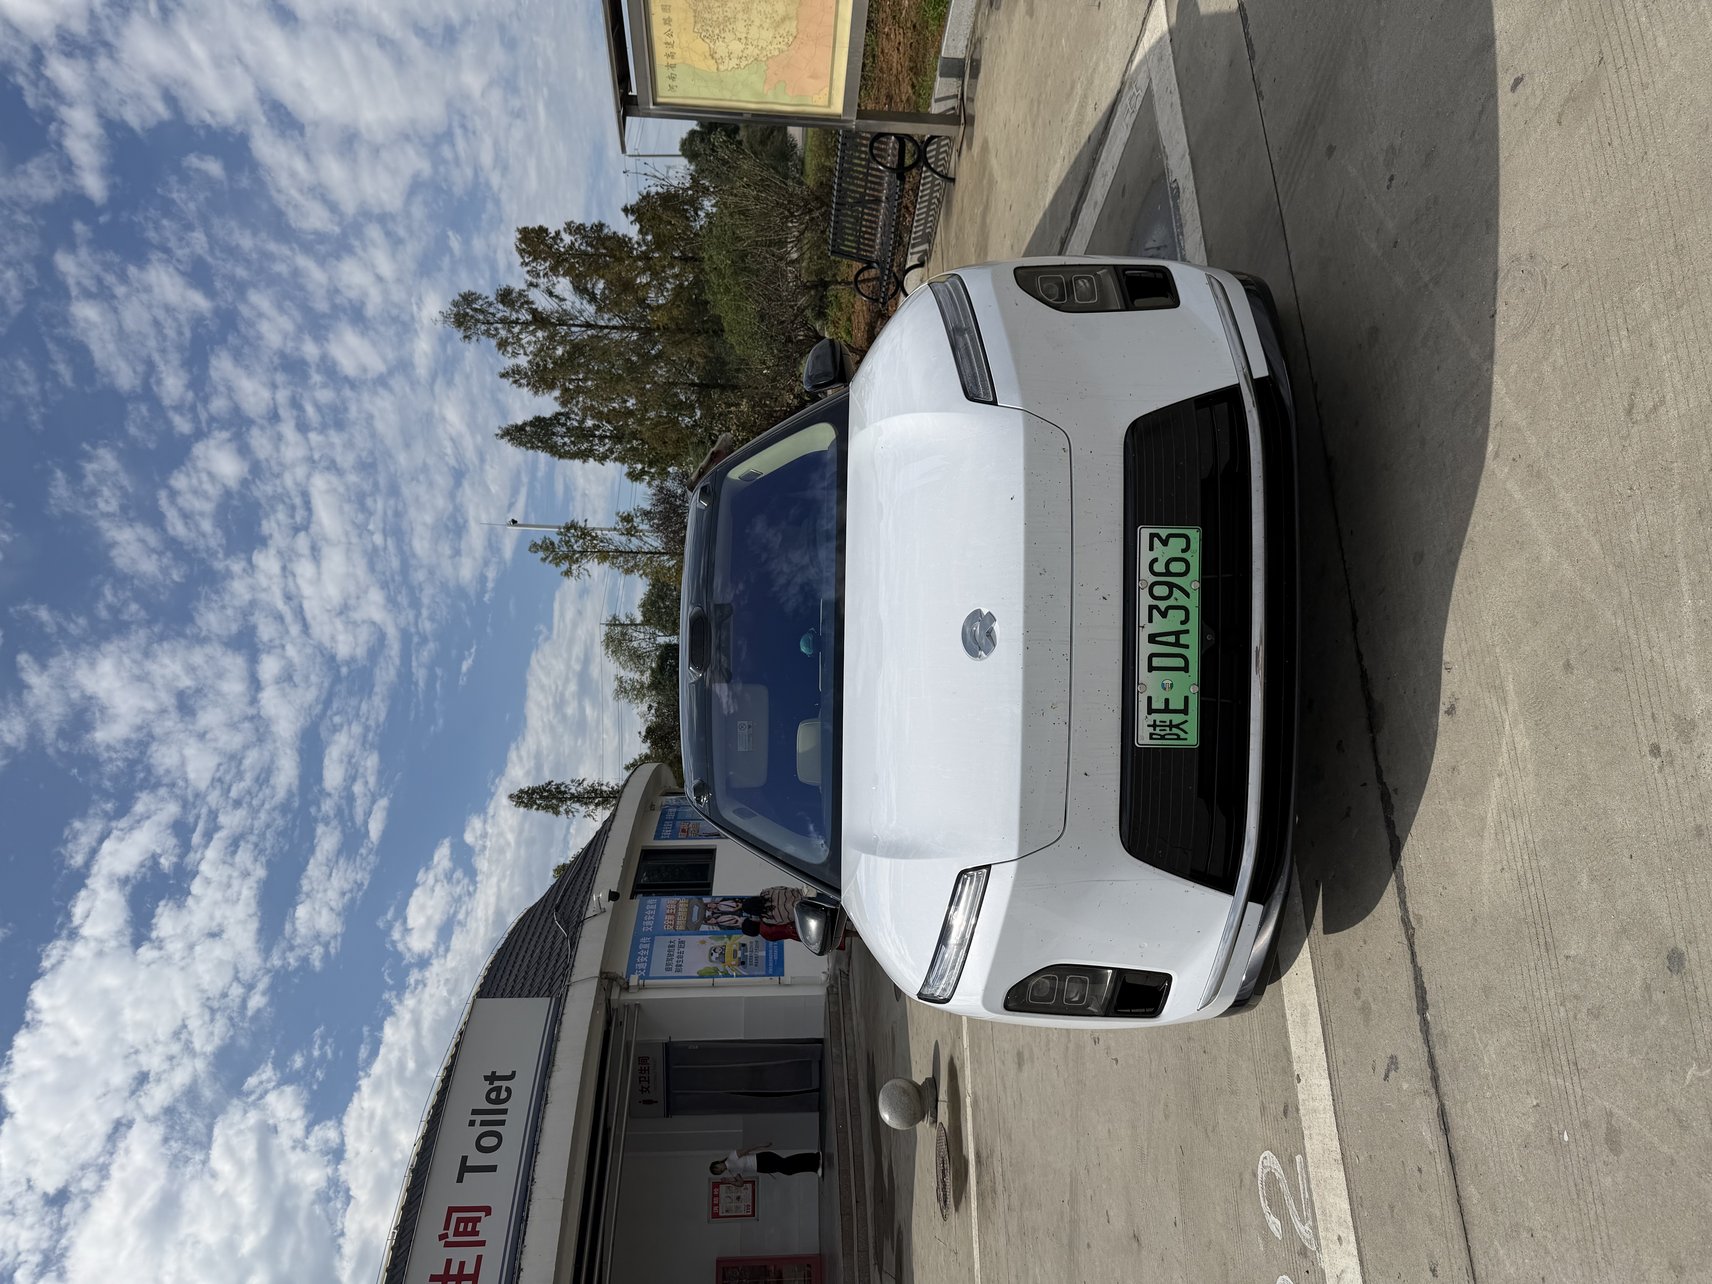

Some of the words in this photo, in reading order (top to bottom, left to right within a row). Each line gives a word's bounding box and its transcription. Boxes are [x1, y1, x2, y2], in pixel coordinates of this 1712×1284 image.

[660, 4, 678, 92] 河南省高速公路图
[634, 936, 651, 976] 交通安全宣传
[638, 1056, 650, 1094] 女卫生间
[456, 1070, 516, 1183] Toilet
